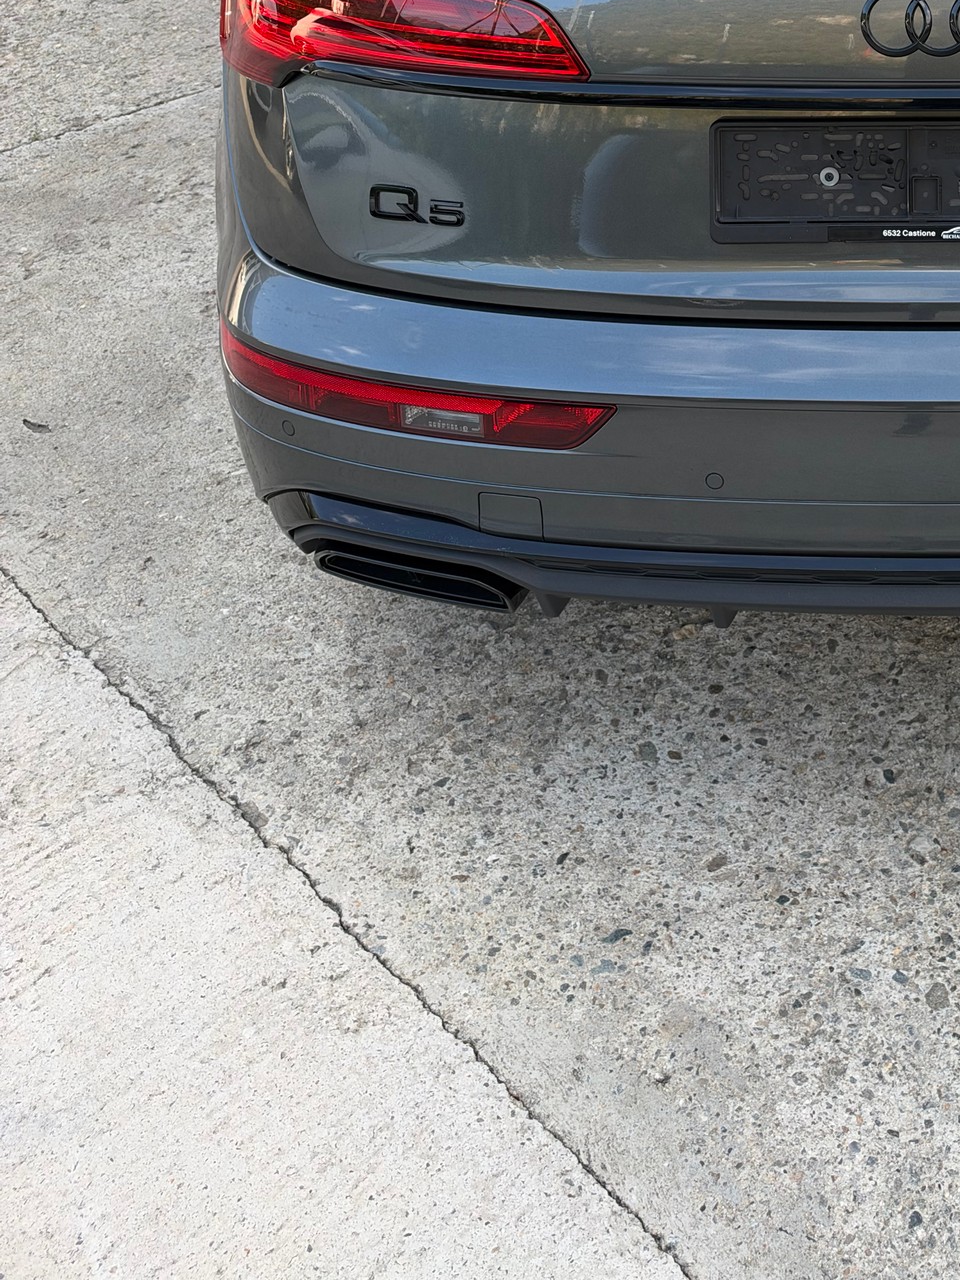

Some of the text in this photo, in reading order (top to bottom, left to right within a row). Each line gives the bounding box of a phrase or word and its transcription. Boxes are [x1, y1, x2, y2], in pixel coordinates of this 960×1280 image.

[369, 183, 465, 227] Q5
[882, 229, 936, 237] 6532 Castione
